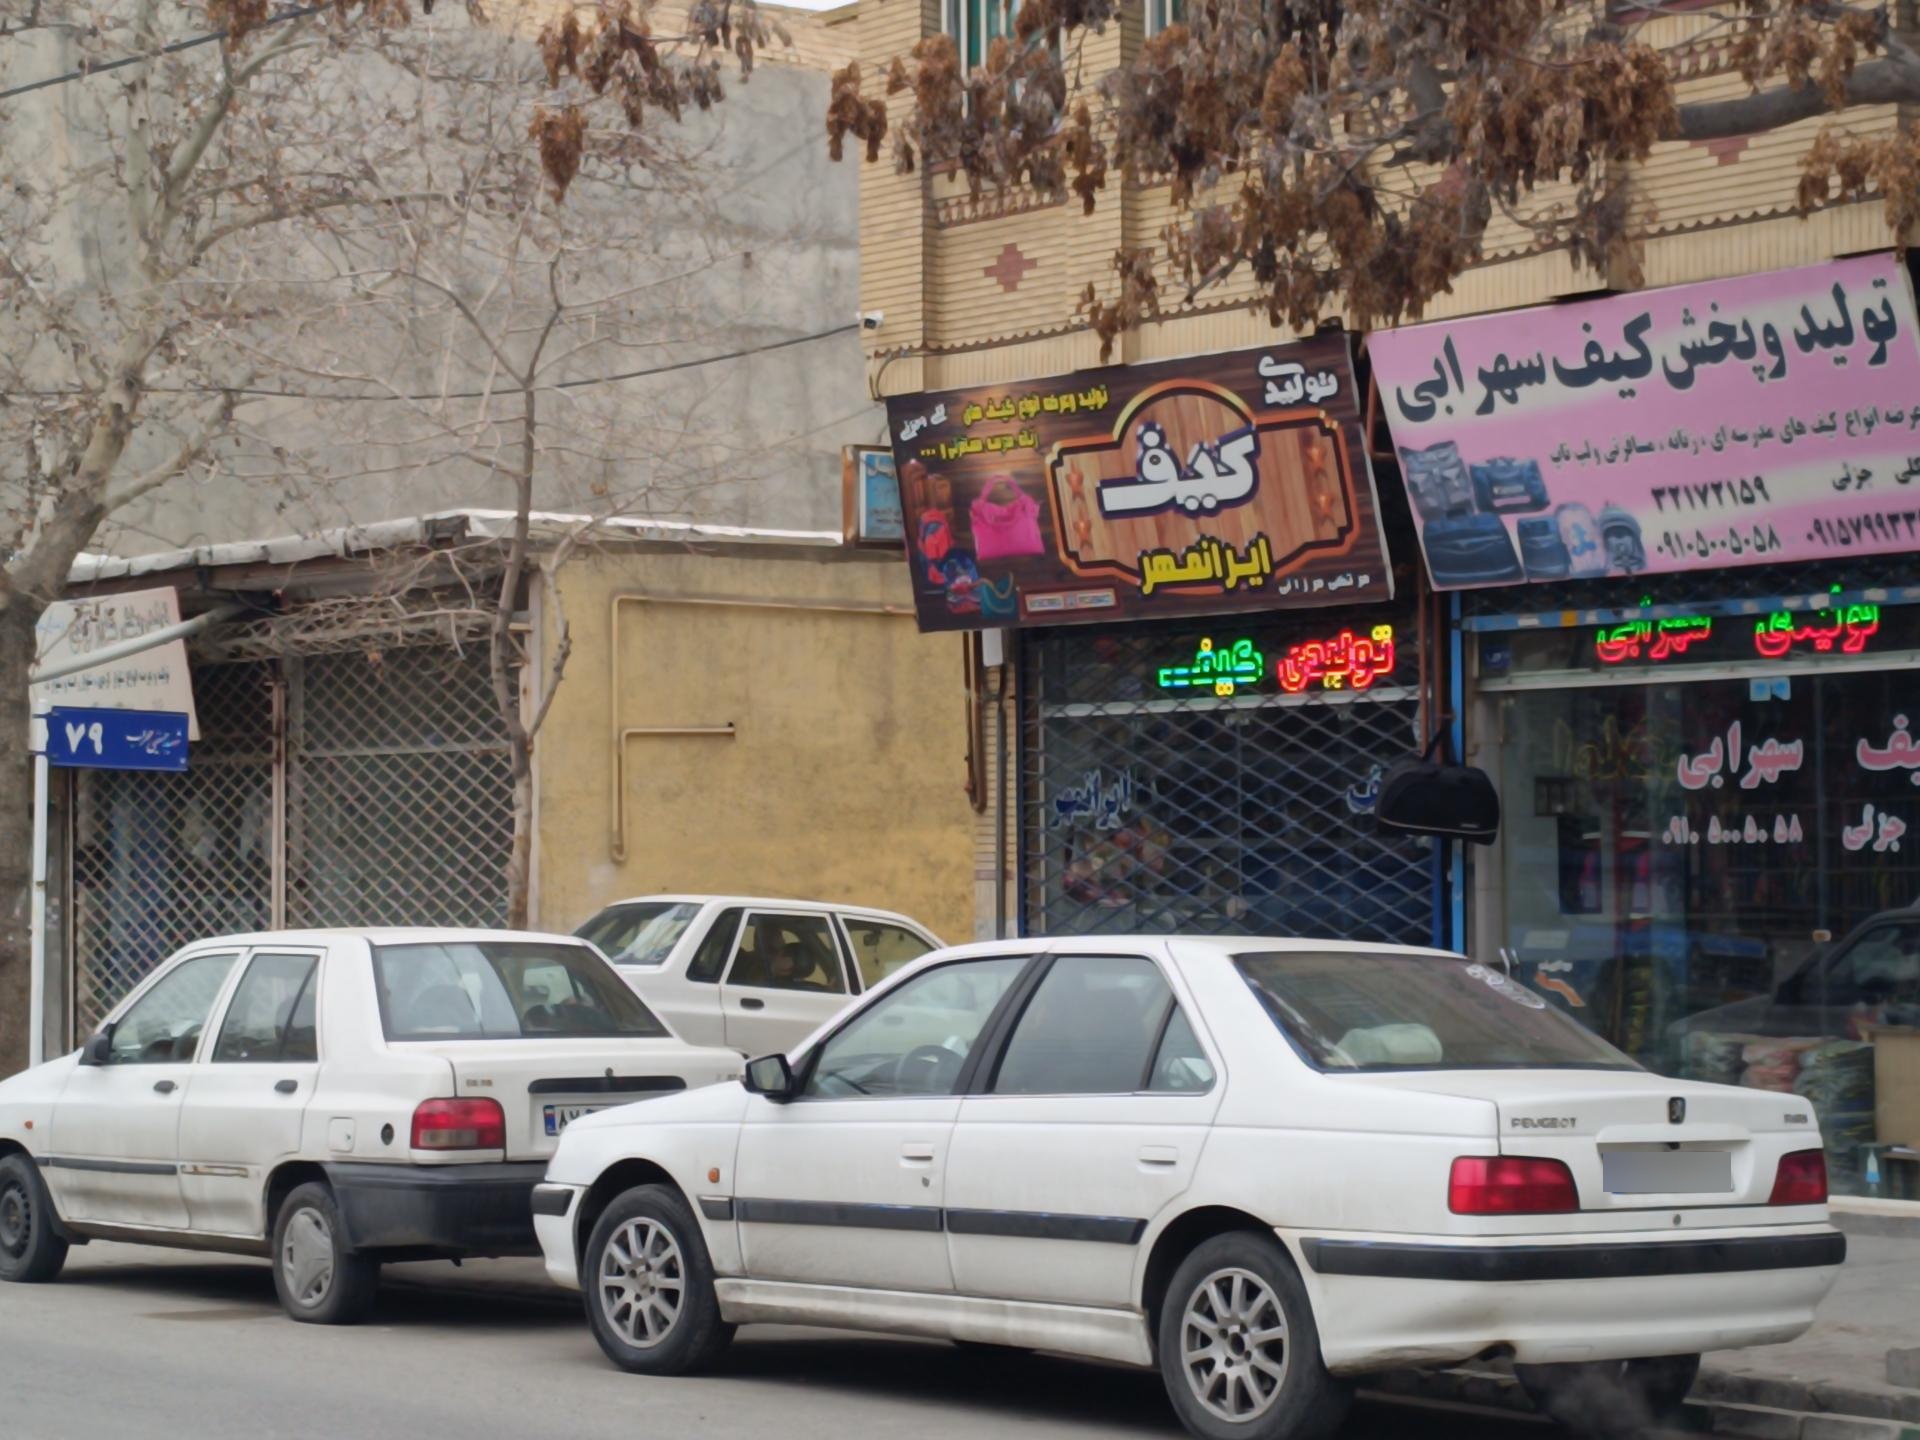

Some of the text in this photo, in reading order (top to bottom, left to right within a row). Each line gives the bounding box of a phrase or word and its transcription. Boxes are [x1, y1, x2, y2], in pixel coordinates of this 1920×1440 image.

[1258, 356, 1339, 405] تولیدی
[1395, 335, 1546, 422] سهرابی
[1102, 424, 1257, 511] کیف
[1597, 584, 1880, 662] تولیدی سهرابی
[1158, 624, 1394, 695] تولیدی کیف
[65, 722, 103, 755] ۷۹
[1677, 720, 1804, 790] سهرابی
[1511, 1116, 1576, 1129] PEUGEOT
